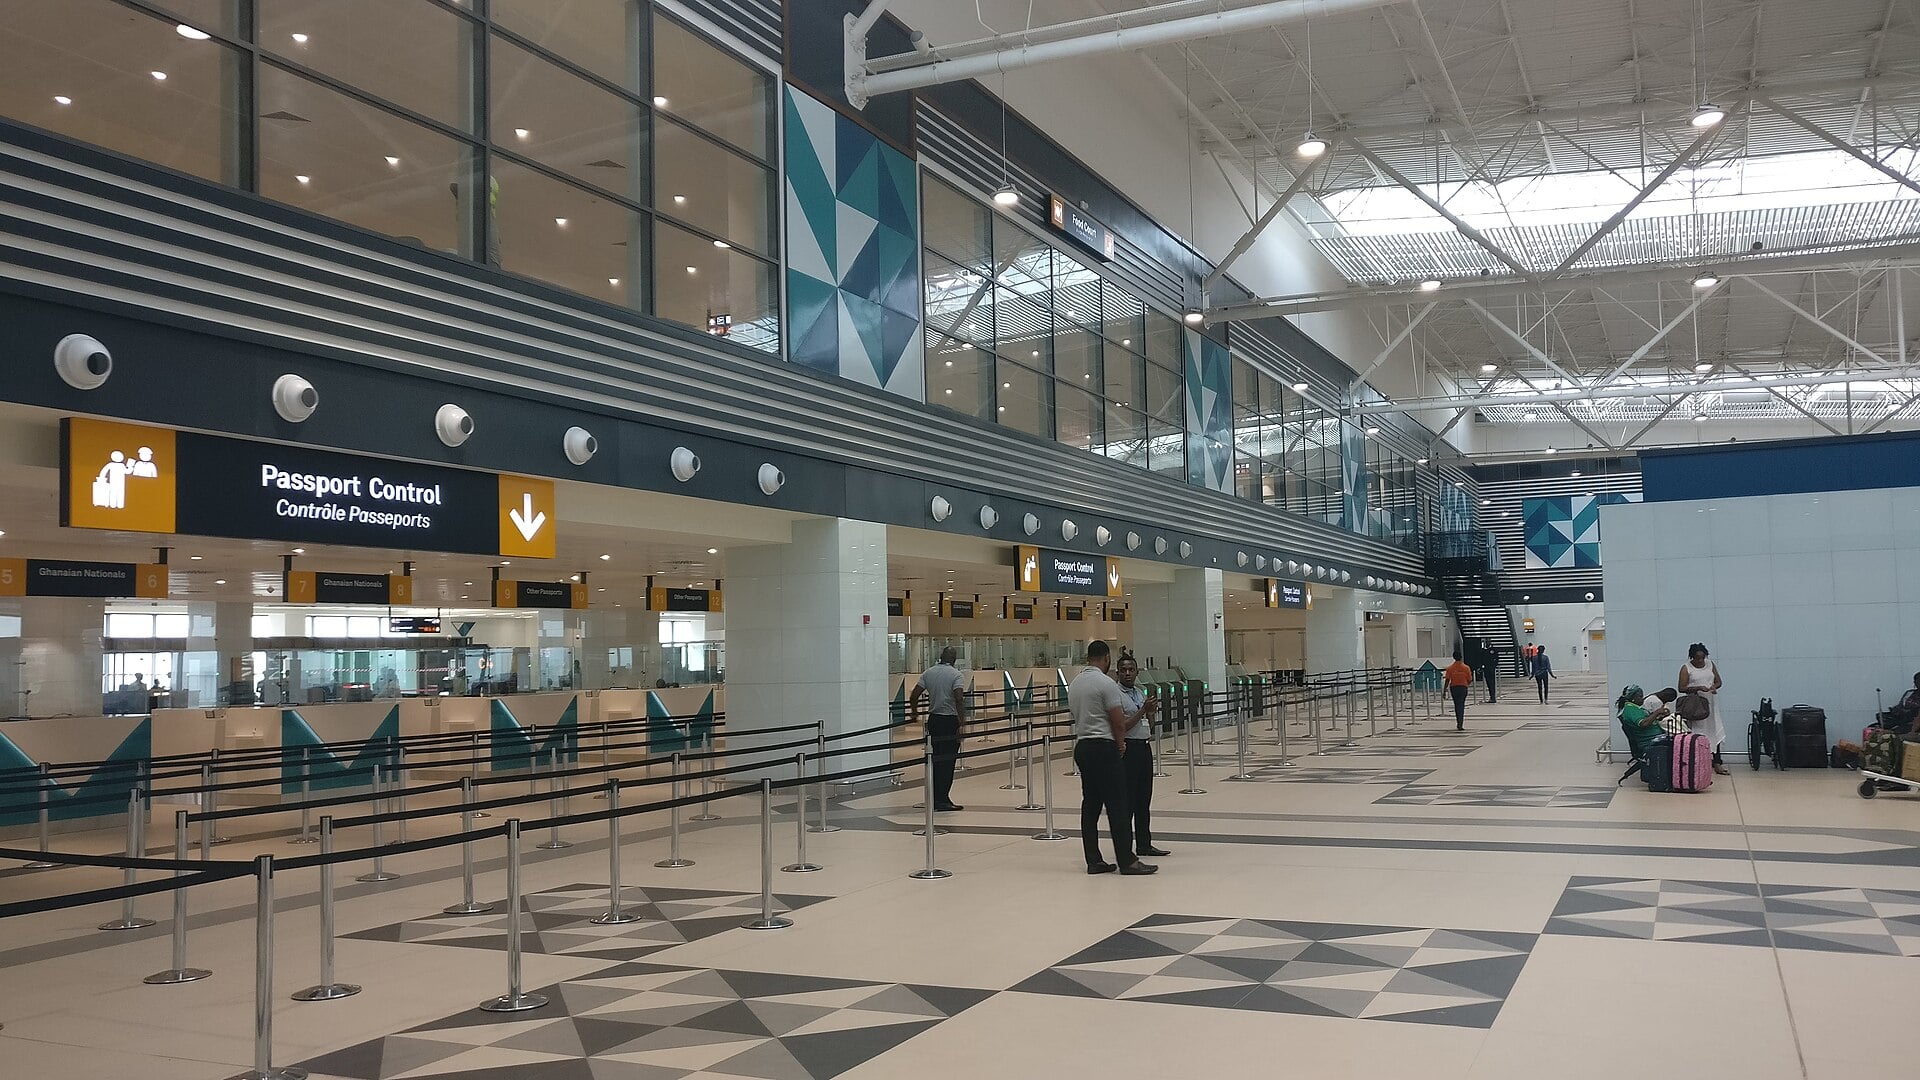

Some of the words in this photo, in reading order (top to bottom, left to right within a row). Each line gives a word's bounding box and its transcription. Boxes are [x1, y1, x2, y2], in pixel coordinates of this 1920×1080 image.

[1072, 213, 1084, 230] Food
[261, 464, 361, 498] Passport
[368, 477, 441, 505] Control
[276, 498, 346, 521] Contrôle
[349, 506, 431, 529] Passeports
[1054, 558, 1076, 573] Passport
[1077, 562, 1094, 573] Control
[2, 569, 12, 584] 5
[38, 567, 82, 578] Ghanaian
[83, 568, 126, 579] Nationals
[147, 574, 157, 588] 6
[299, 580, 306, 593] 7
[323, 578, 353, 587] Ghanaian
[353, 579, 383, 588] Nationals
[397, 584, 404, 596] 8
[504, 588, 511, 599] 9
[526, 587, 540, 595] Other
[575, 591, 585, 602] 10
